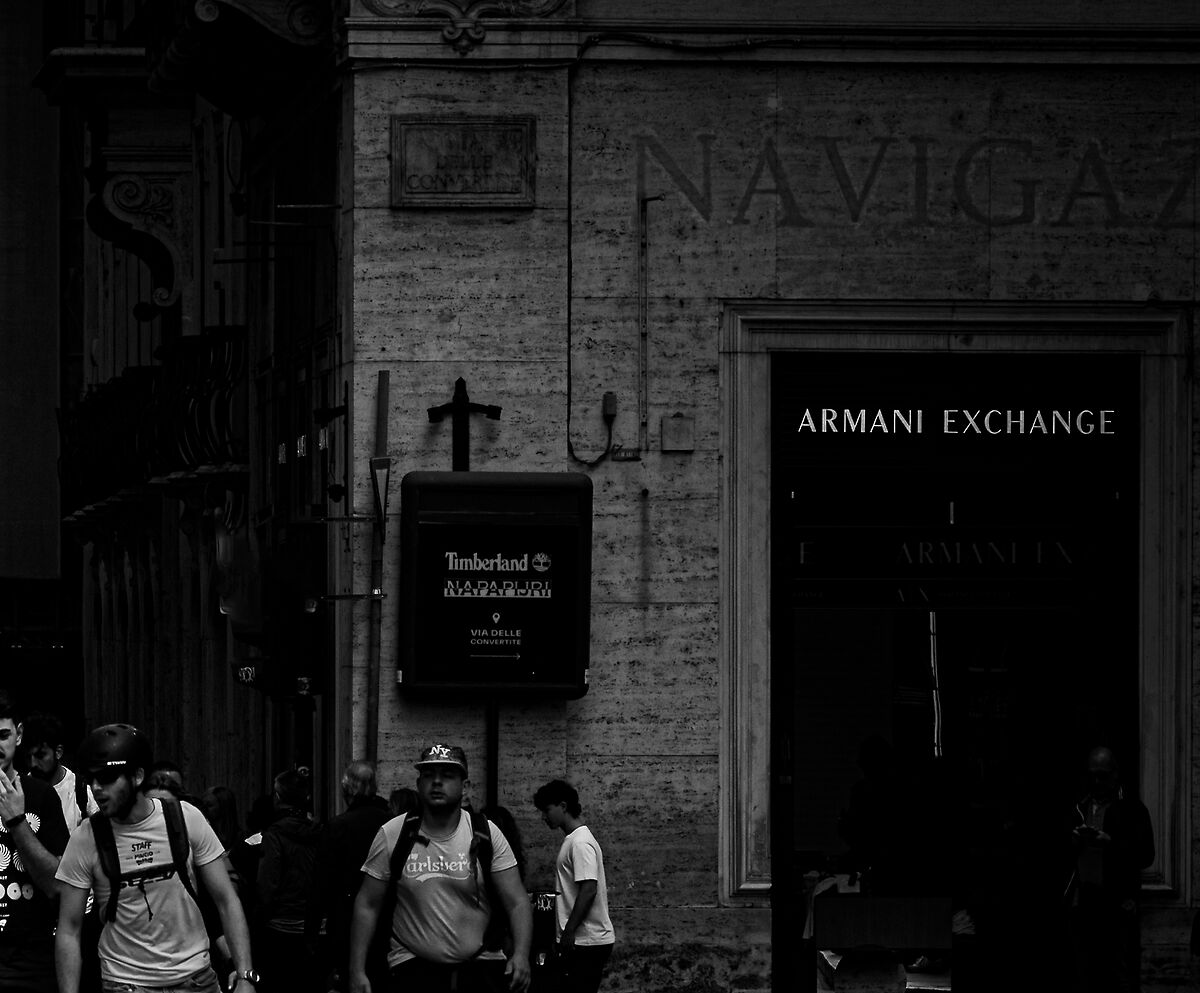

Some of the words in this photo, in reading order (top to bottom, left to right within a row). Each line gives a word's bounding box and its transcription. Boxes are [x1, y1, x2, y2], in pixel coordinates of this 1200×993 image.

[797, 409, 923, 433] ARMANI
[943, 409, 1115, 435] EXCHANGE
[445, 552, 528, 571] Timberland
[444, 579, 551, 598] NAPAPIJRI
[470, 629, 489, 637] VIA
[491, 629, 521, 637] DELLE
[429, 745, 450, 758] NY
[131, 841, 153, 852] STAFF
